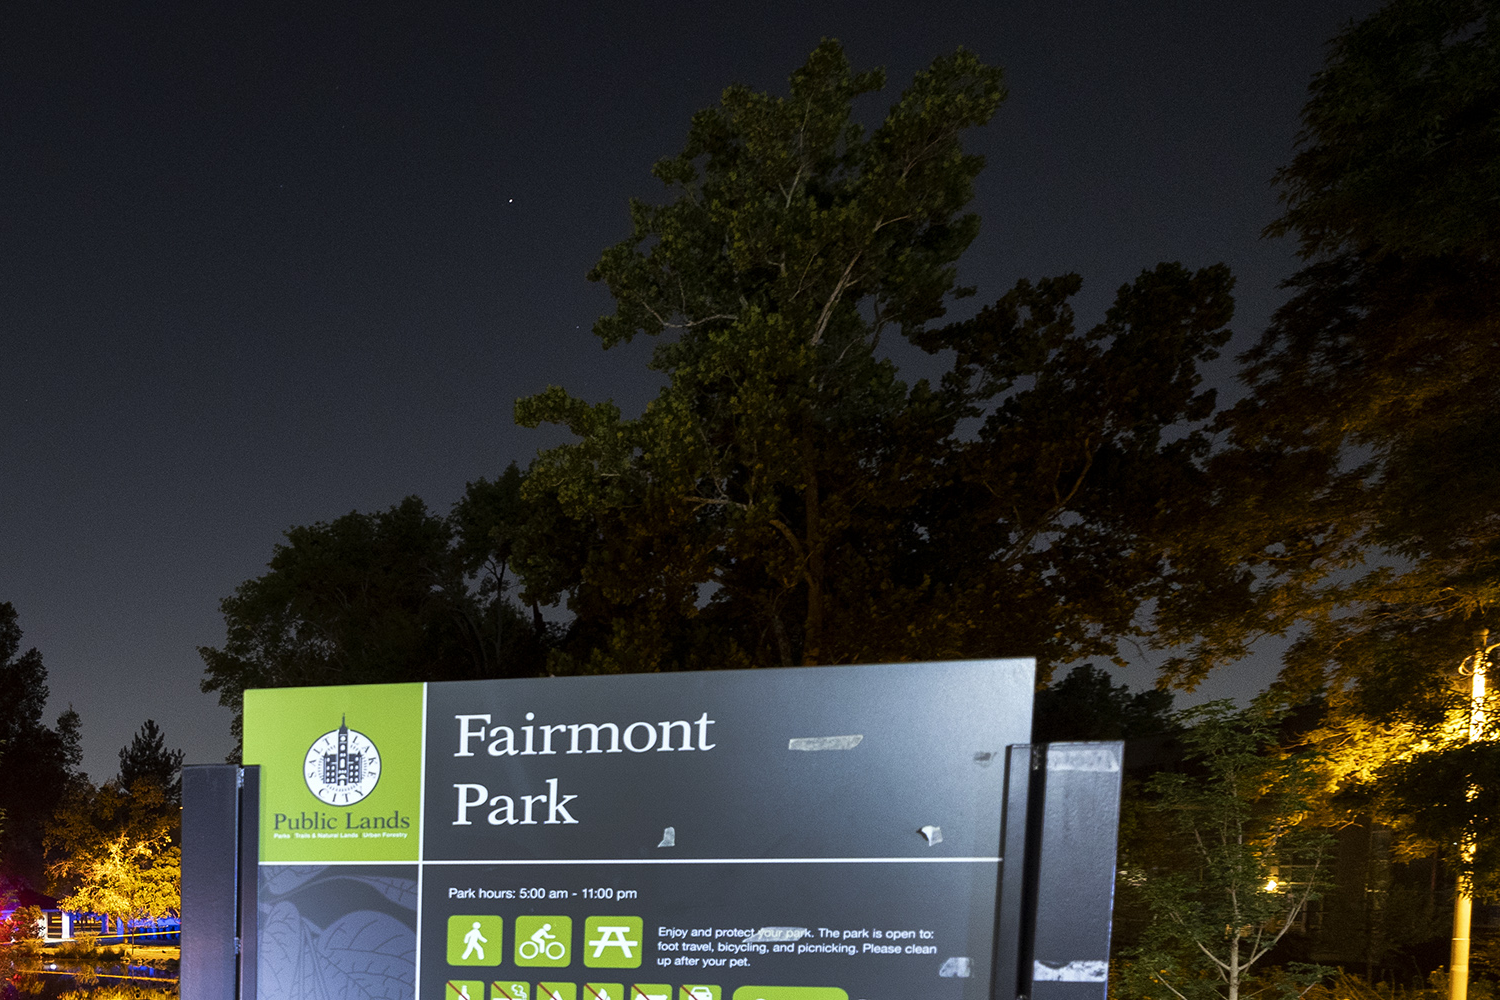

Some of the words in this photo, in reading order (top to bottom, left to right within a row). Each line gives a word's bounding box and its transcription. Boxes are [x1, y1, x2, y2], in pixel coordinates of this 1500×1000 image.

[453, 712, 716, 757] Fairmont
[308, 736, 330, 779] SALT
[352, 735, 378, 779] LAKE
[318, 785, 364, 803] CITY
[452, 778, 579, 825] Park
[274, 811, 338, 830] Public
[345, 810, 411, 830] Lands
[448, 887, 476, 899] Park
[478, 888, 516, 899] hours:
[519, 887, 546, 899] 5:00
[548, 890, 568, 899] am
[582, 887, 613, 899] 11:00
[616, 890, 637, 901] pm
[658, 926, 688, 939] Enjoy
[690, 927, 712, 937] and
[715, 927, 755, 939] protect
[758, 930, 783, 940] your
[785, 927, 814, 939] park.
[818, 927, 840, 938] The
[842, 928, 869, 940] park
[872, 928, 882, 938] is
[885, 930, 916, 941] open
[919, 929, 934, 939] to:
[657, 941, 679, 951] foot
[681, 941, 714, 953] travel,
[717, 942, 770, 954] bicycling,
[773, 943, 795, 953] and
[798, 943, 858, 956] picnicking.
[862, 943, 902, 954] Please
[904, 944, 937, 954] clean
[657, 957, 672, 967] up
[674, 956, 700, 966] after
[702, 958, 727, 968] your
[729, 957, 750, 968] pet.
